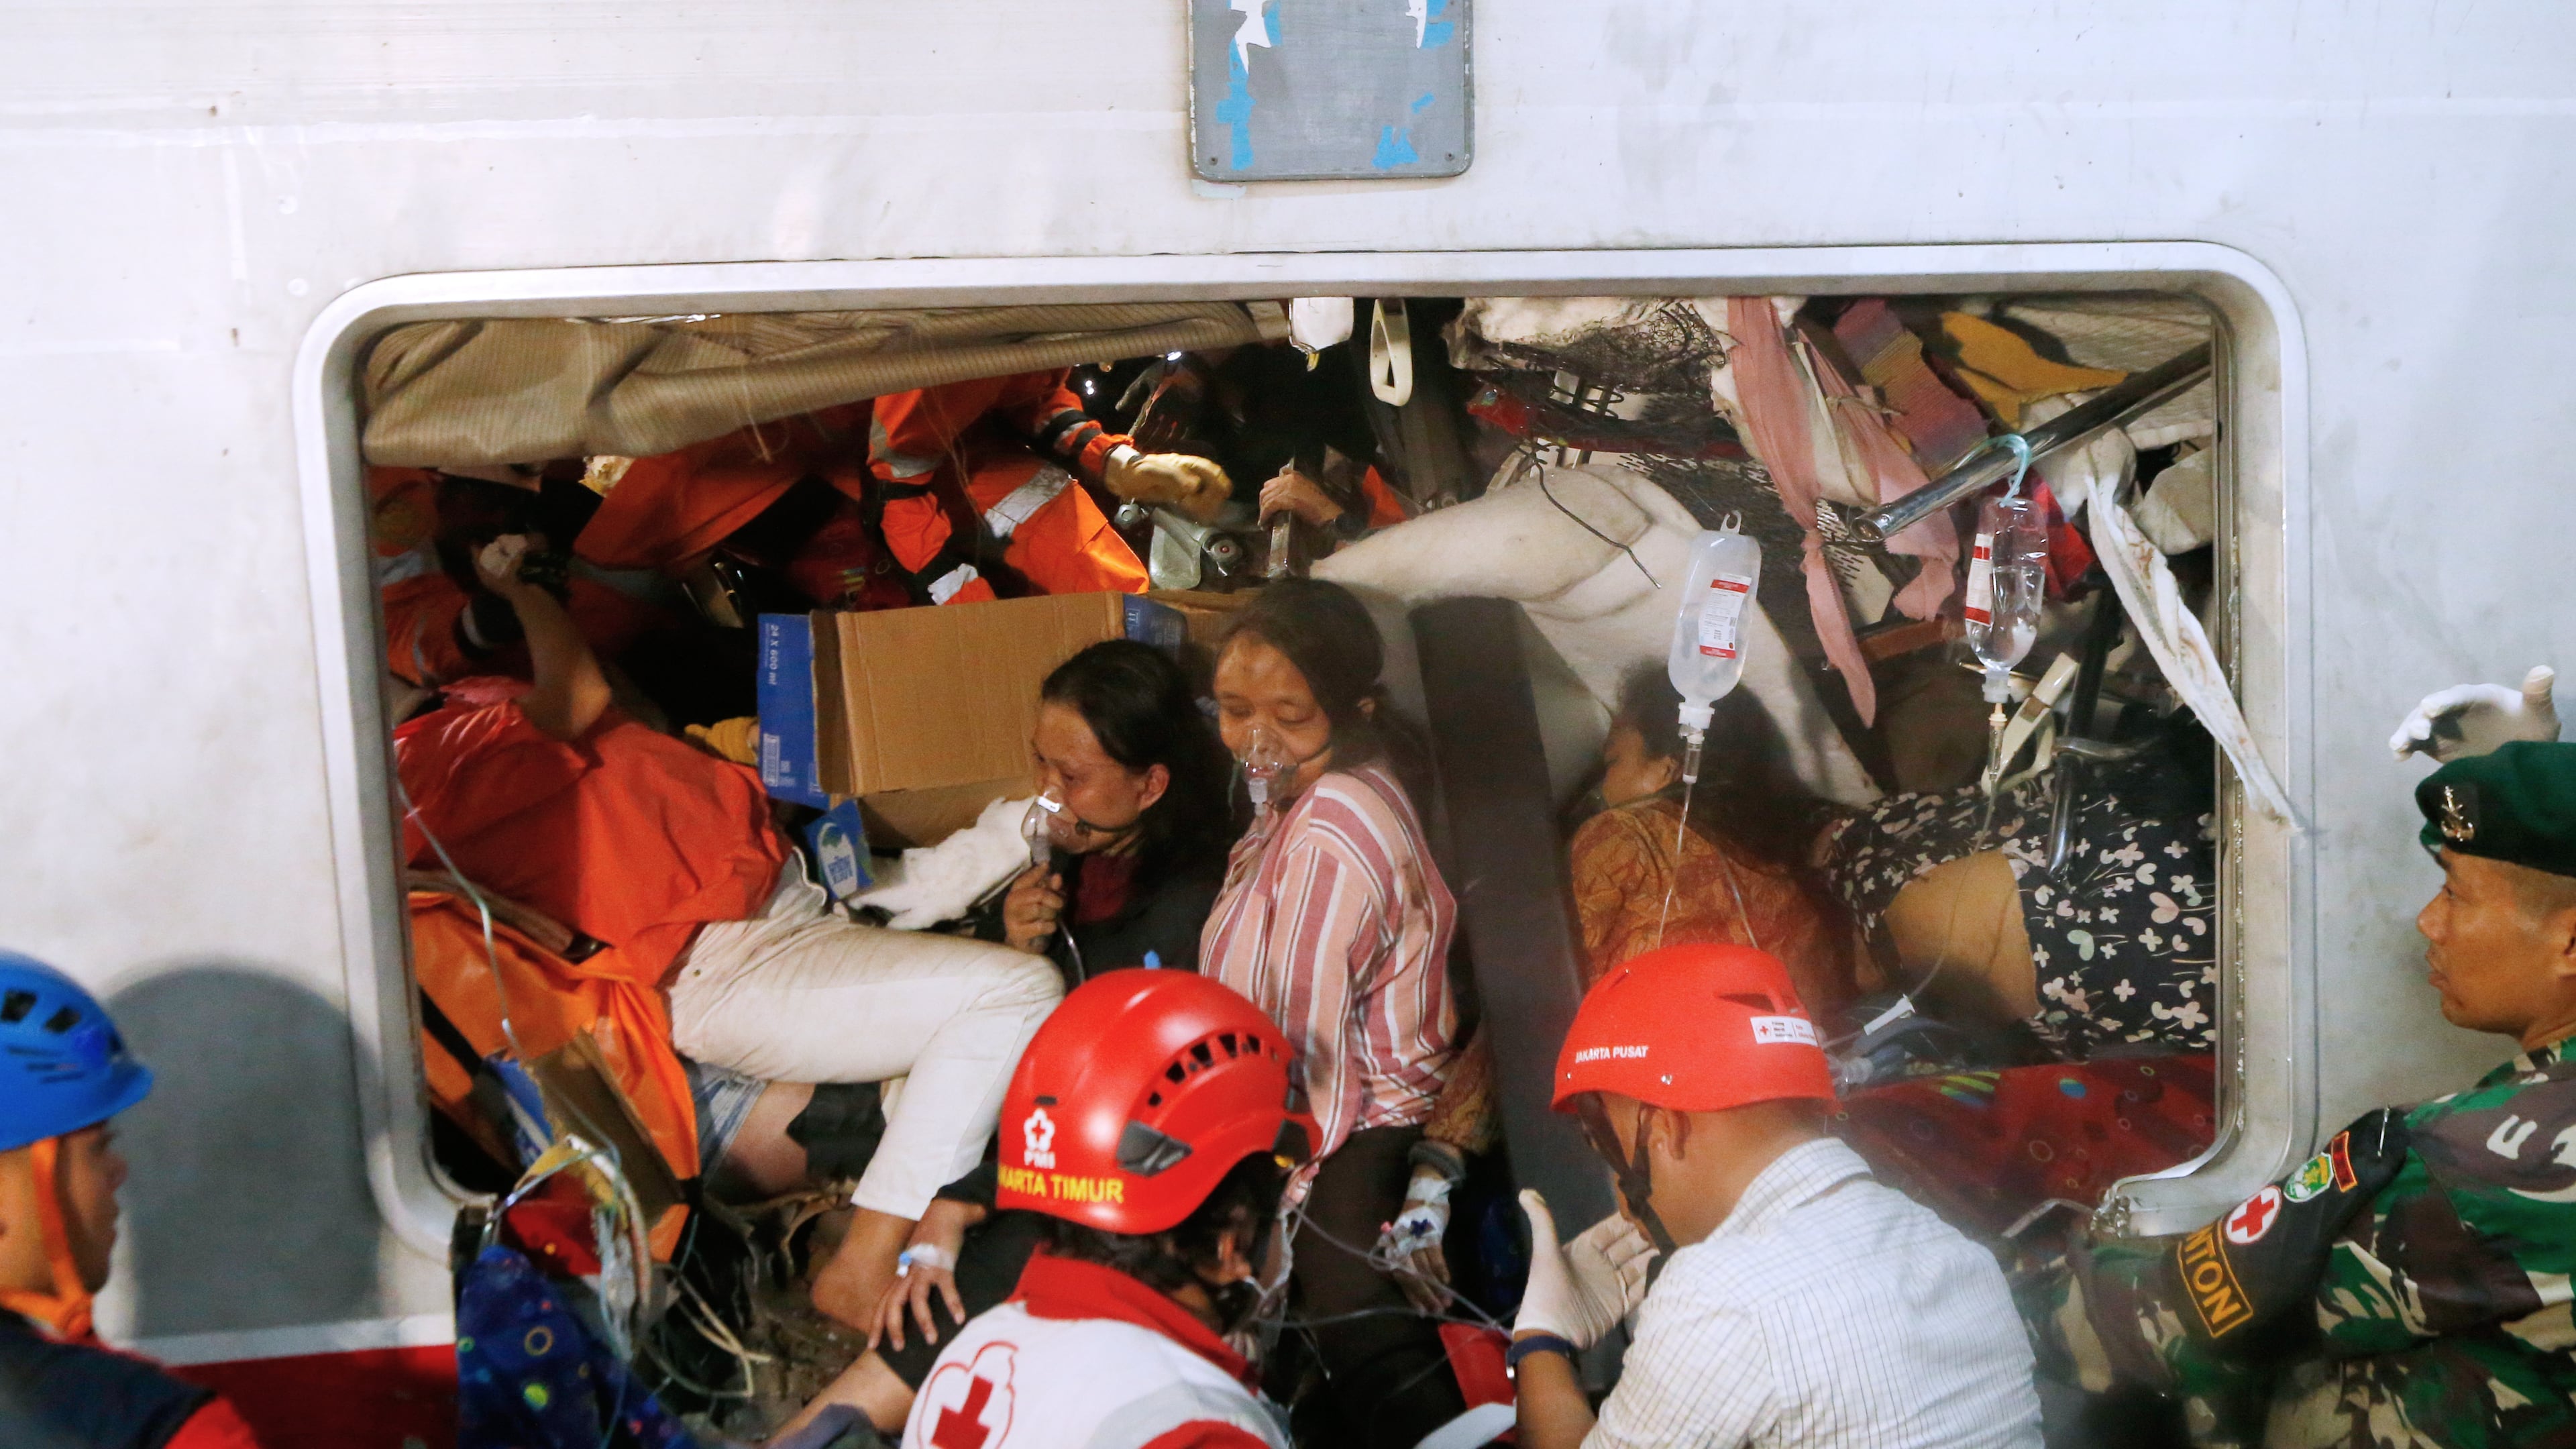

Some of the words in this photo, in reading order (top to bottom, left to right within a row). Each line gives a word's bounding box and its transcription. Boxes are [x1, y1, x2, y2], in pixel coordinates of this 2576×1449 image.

[769, 649, 777, 669] 600
[1575, 1046, 1611, 1063] JAKARTA
[1613, 1045, 1648, 1059] PUSAT
[1051, 1174, 1124, 1204] TIMUR
